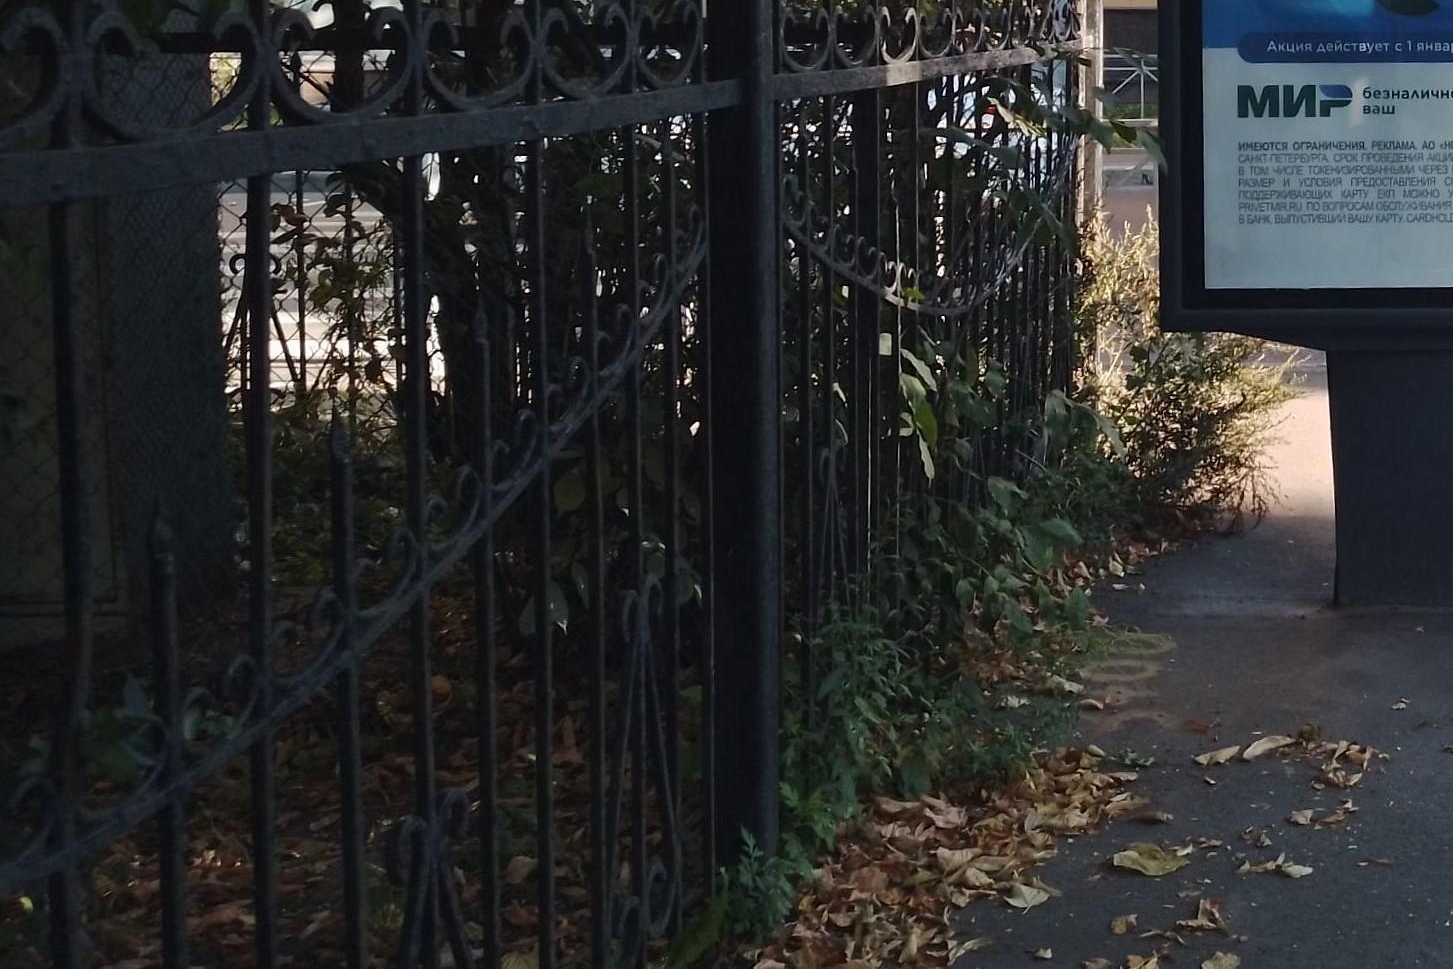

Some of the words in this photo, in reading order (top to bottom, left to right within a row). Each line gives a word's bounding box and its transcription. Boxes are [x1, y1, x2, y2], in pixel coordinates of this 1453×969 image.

[1267, 39, 1313, 55] Акция
[1317, 37, 1391, 55] действует
[1395, 42, 1403, 52] с
[1407, 40, 1414, 51] 1
[1236, 84, 1353, 119] МИР
[1363, 104, 1396, 115] ваш
[1238, 141, 1287, 151] ИМЕЮТСЯ
[1422, 141, 1435, 150] АО
[1341, 190, 1368, 199] КАРТУ
[1348, 214, 1373, 223] ВАШУ
